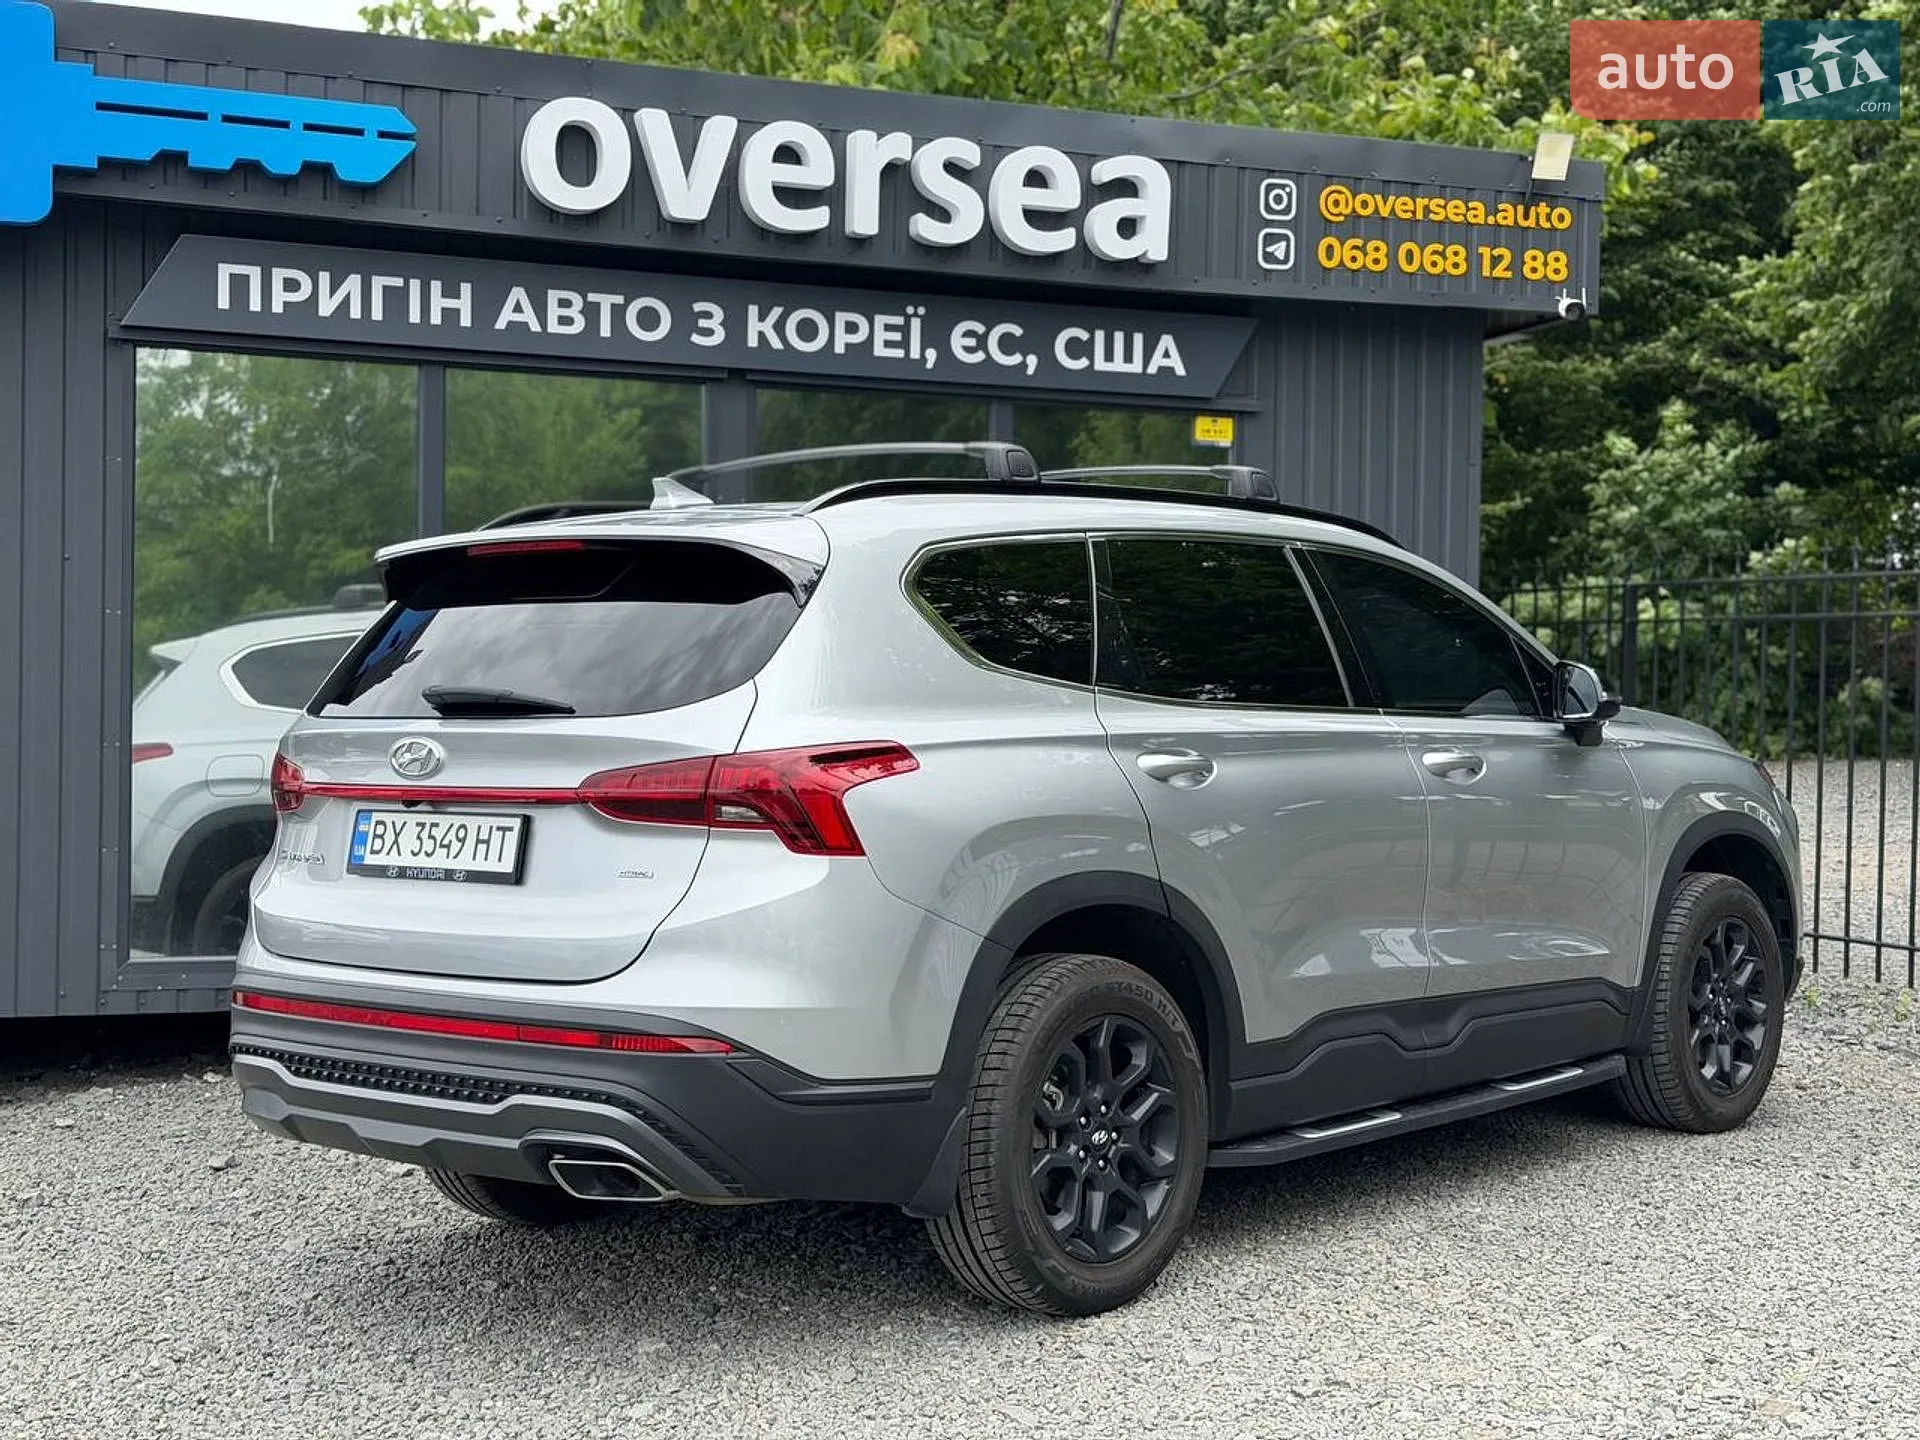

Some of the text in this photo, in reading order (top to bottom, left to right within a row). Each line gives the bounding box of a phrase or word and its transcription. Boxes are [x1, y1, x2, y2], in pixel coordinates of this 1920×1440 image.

[520, 97, 1171, 264] oversea
[1319, 184, 1572, 229] @oversea.auto
[1318, 236, 1569, 282] 068 068 12 88
[217, 262, 1187, 377] ПРИГІН АВТО З КОРЕЇ, ЄС, США
[369, 820, 514, 863] BX 3549 HT
[406, 868, 446, 880] HYUNDAI
